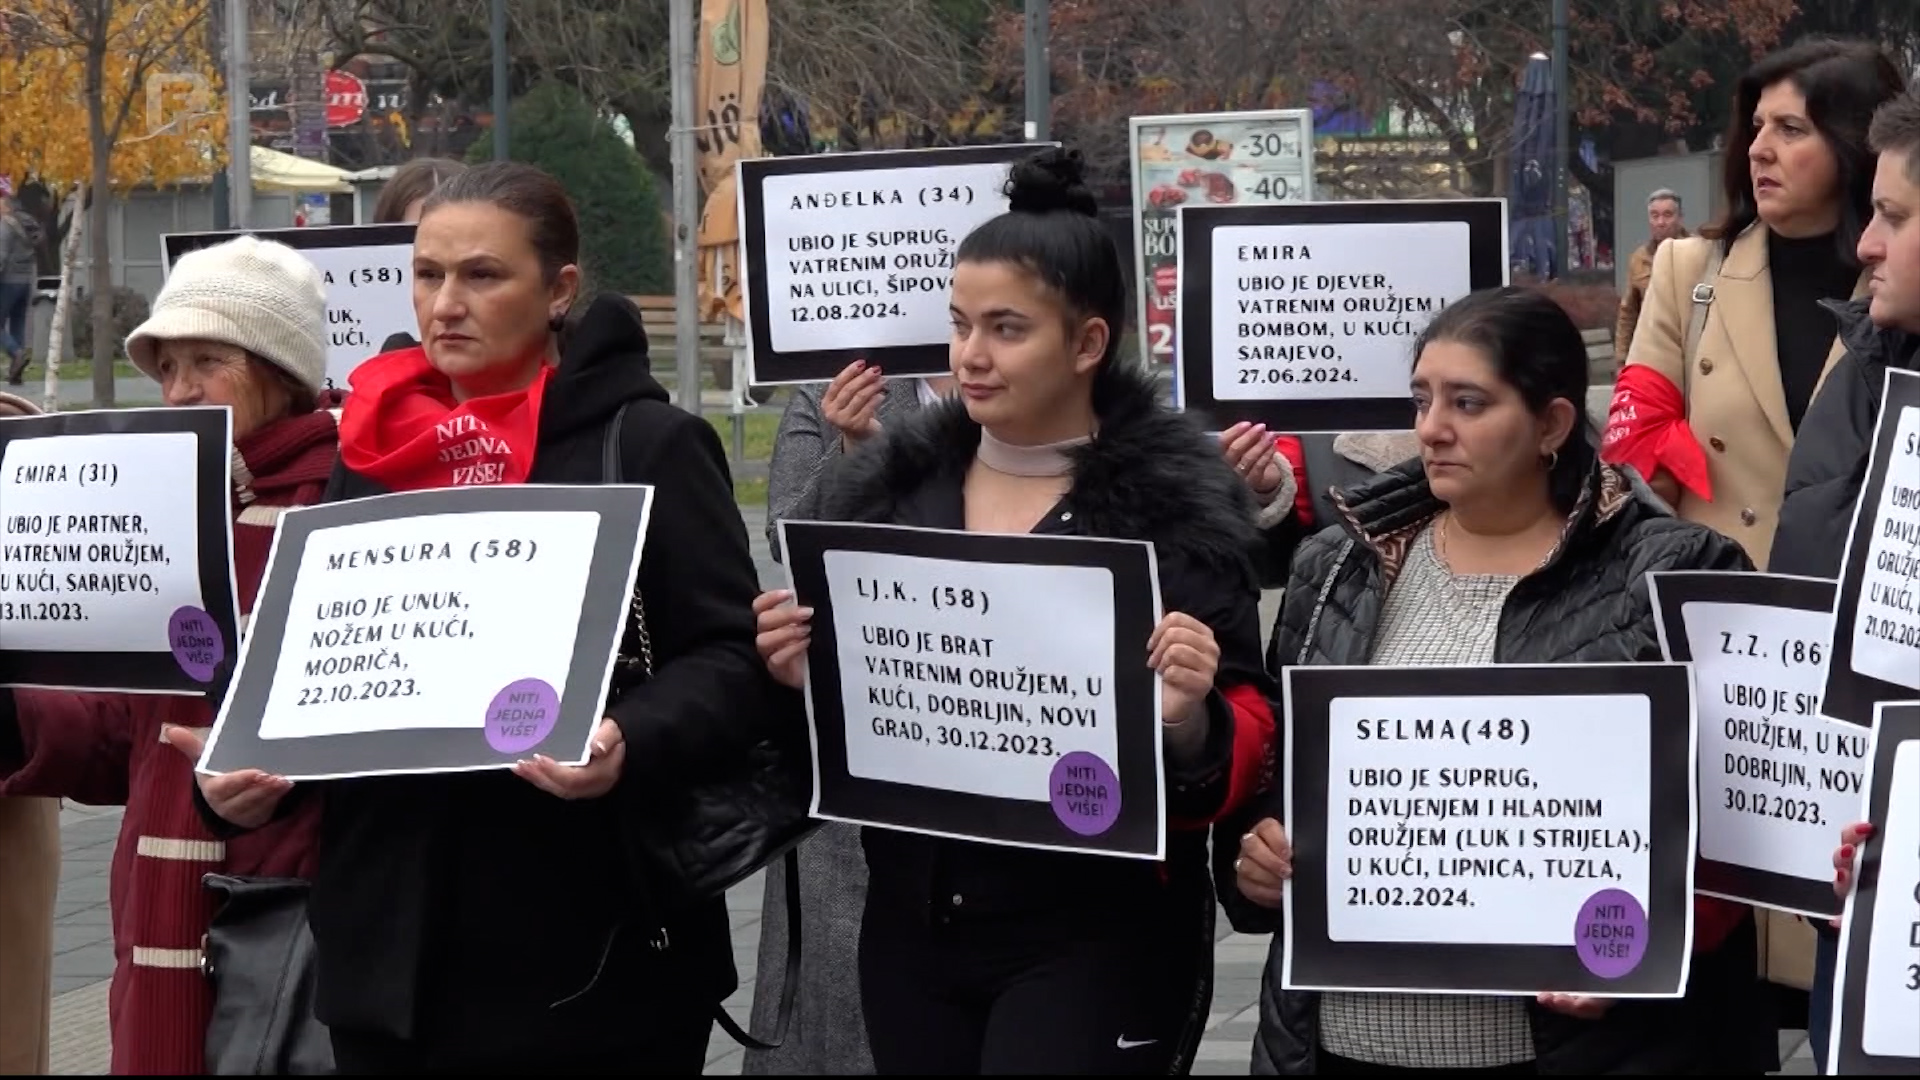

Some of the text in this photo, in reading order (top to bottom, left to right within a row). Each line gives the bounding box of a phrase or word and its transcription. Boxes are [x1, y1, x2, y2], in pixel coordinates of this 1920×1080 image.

[1241, 133, 1294, 158] -30%
[790, 185, 974, 210] ANĐELKA (34)
[1245, 177, 1301, 200] -40%
[788, 229, 956, 252] UBIO JE SUPRUG,
[1238, 245, 1312, 261] EMIRA
[789, 248, 955, 275] VATRENIM ORUŽJ
[350, 267, 402, 288] (58)
[790, 273, 953, 298] NA ULICI, ŠIPOV
[1238, 275, 1393, 293] UBIO JE DJEVER,
[791, 303, 907, 322] 12.08.2024.
[1238, 298, 1334, 313] VATRENIM
[1343, 293, 1432, 314] ORUŽJEM
[328, 309, 361, 325] UK,
[1238, 314, 1418, 338] BOMBOM, U KUĆI,
[327, 327, 370, 347] UĆI,
[1238, 345, 1342, 363] SARAJEVO,
[1238, 368, 1358, 384] 27.06.2024.
[438, 437, 513, 463] JEDNA
[15, 463, 118, 487] EMIRA (31)
[453, 459, 505, 486] VIŠE!
[7, 515, 148, 537] UBIO JE PARTNER,
[4, 538, 170, 566] VATRENIM ORUŽJEM,
[327, 539, 538, 571] MENSURA (58)
[1, 568, 159, 596] U KUĆI, SARAJEVO,
[317, 591, 470, 620] UBIO JE UNUK,
[857, 577, 990, 615] LJ.K. (58)
[1870, 581, 1882, 602] U
[1882, 578, 1913, 615] KUĆI,
[0, 602, 88, 621] 13.11.2023.
[177, 634, 214, 649] JEDNA
[310, 614, 474, 649] NOŽEM U KUĆI,
[862, 625, 994, 658] UBIO JE BRAT
[1865, 615, 1920, 648] 21.02.202
[1720, 631, 1829, 668] Z.Z. (86
[304, 648, 408, 677] MODRIČA,
[865, 655, 1102, 699] VATRENIM ORUŽJEM, U
[297, 678, 421, 706] 22.10.2023.
[509, 692, 540, 704] NITI
[1724, 683, 1766, 710] UBIO
[1771, 690, 1789, 715] JE
[493, 708, 547, 722] JEDNA
[868, 683, 1097, 728] KUĆI, DOBRLJIN, NOVI
[871, 716, 1061, 757] GRAD, 30.12.2023.
[1725, 716, 1869, 759] ORUŽJEM, U KU
[1067, 766, 1096, 781] NITI
[1349, 768, 1538, 791] UBIO JE SUPRUG,
[1725, 753, 1864, 794] DOBRLJIN, NOV
[1057, 783, 1108, 799] JEDNA
[1349, 798, 1602, 820] DAVLJENJEM I HLADNIM
[1724, 787, 1826, 826] 30.12.2023.
[1349, 822, 1651, 852] ORUŽJEM (LUK I STRIJELA),
[1348, 852, 1622, 881] U KUĆI, LIPNICA, TUZLA,
[1347, 887, 1475, 907] 21.02.2024.
[1595, 905, 1625, 920] NITI
[1583, 924, 1634, 939] JEDNA
